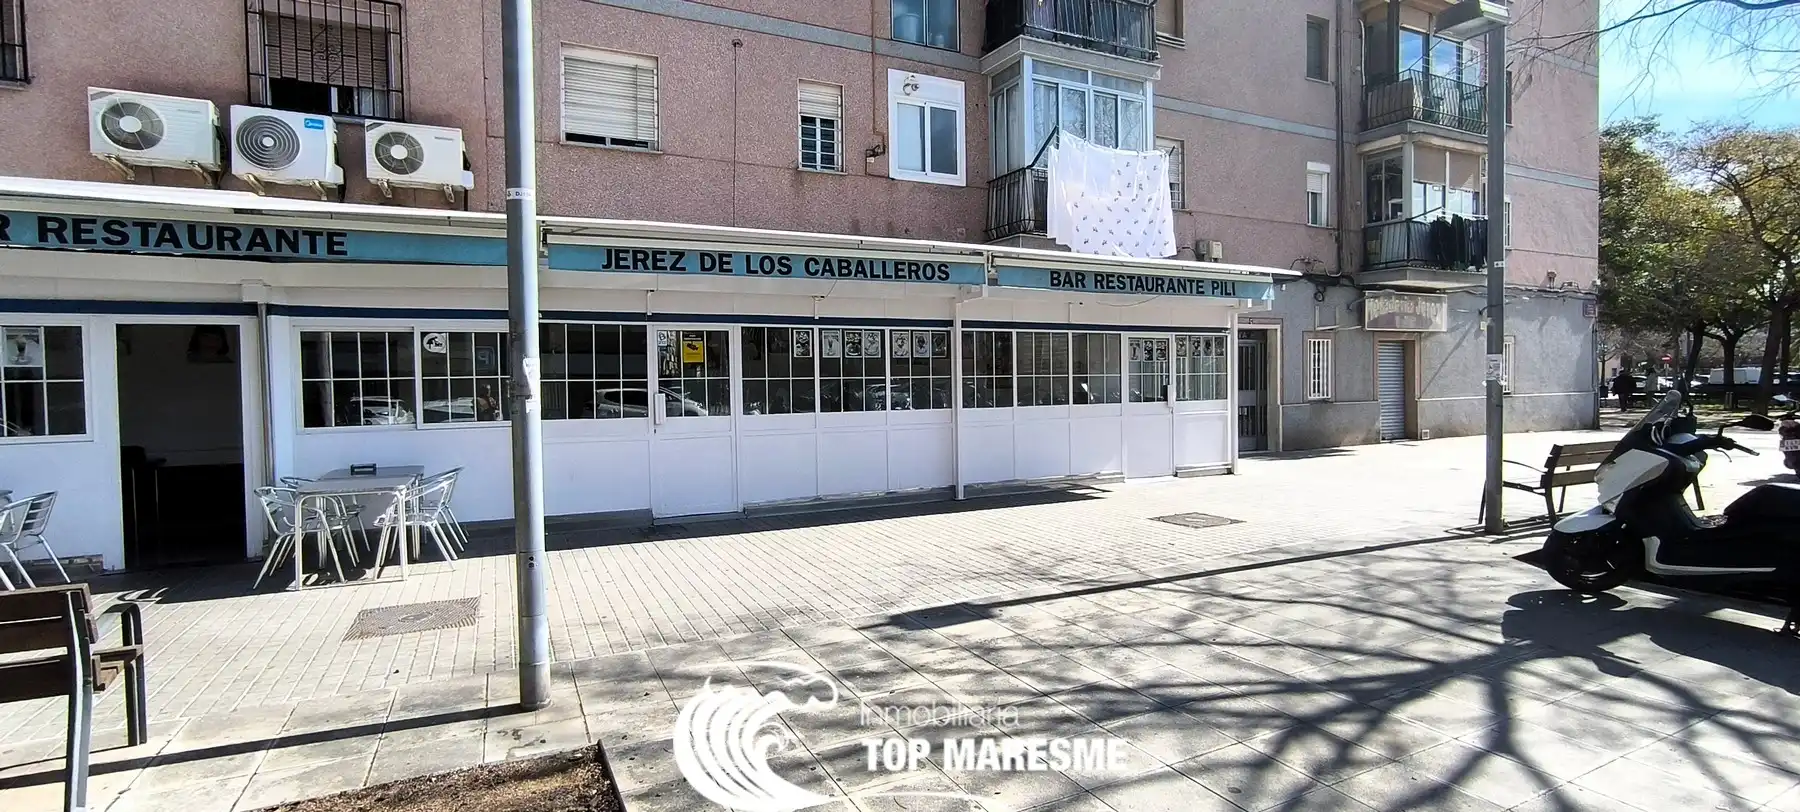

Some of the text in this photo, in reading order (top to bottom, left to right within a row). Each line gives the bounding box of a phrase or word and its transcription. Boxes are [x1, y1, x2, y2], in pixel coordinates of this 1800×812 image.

[37, 216, 348, 255] RESTAURANTE
[601, 248, 951, 282] JEREZ DE LOS CABALLEROS
[1050, 270, 1236, 296] BAR RESTAURANTE PILI
